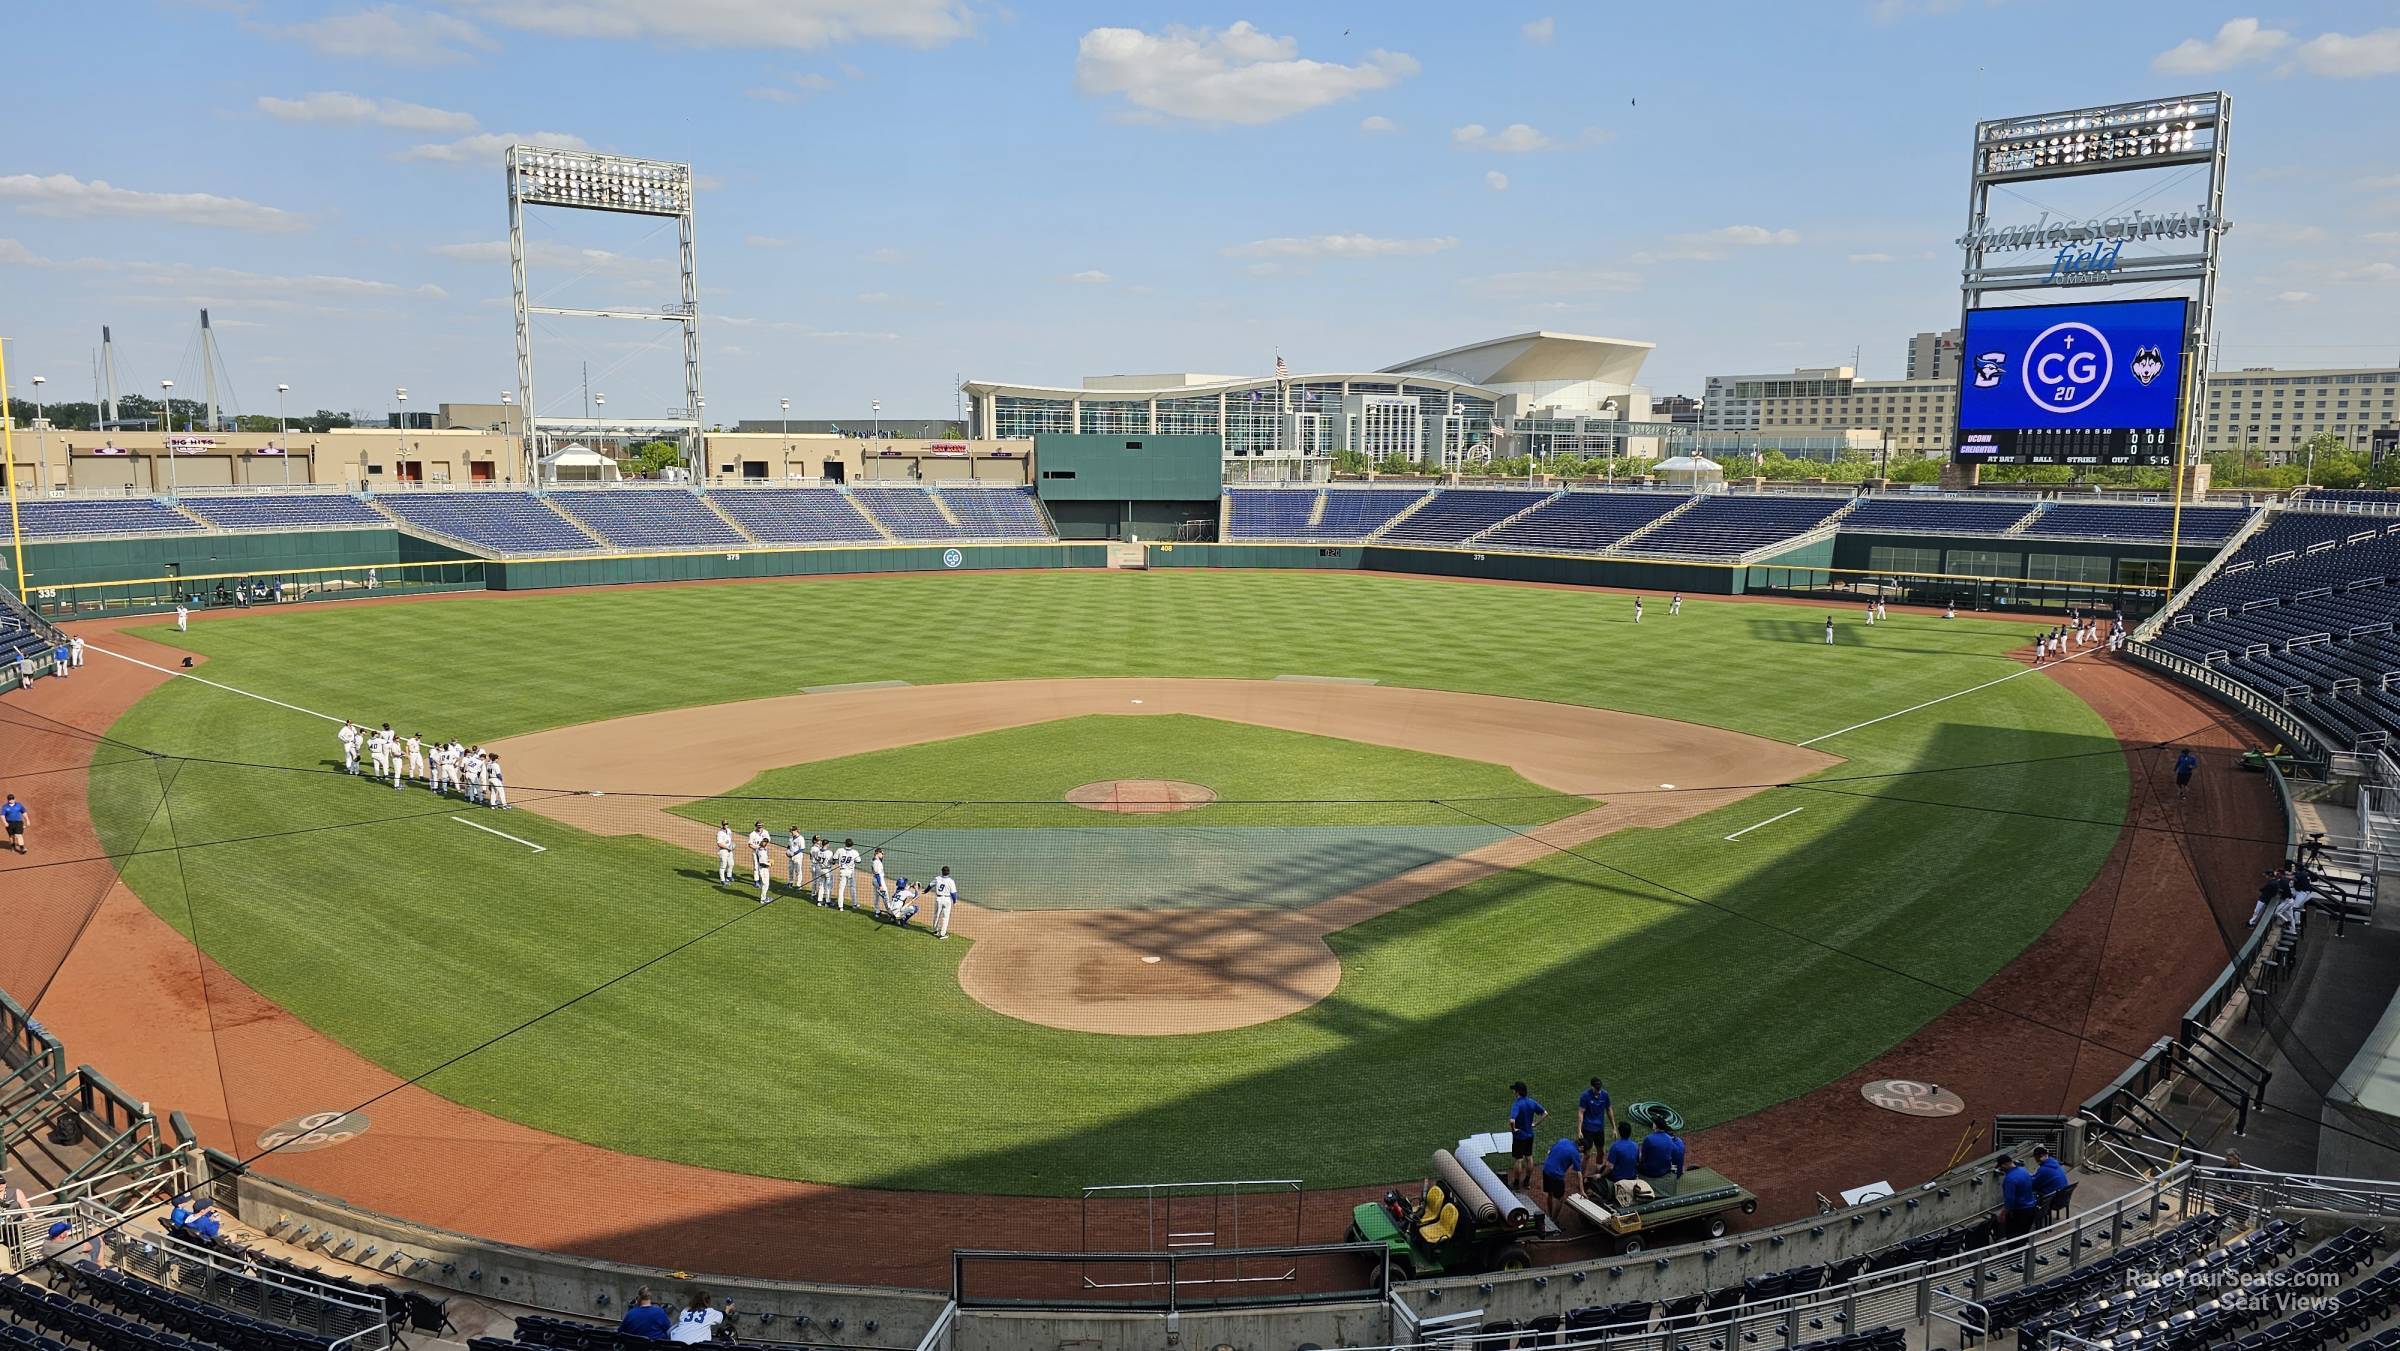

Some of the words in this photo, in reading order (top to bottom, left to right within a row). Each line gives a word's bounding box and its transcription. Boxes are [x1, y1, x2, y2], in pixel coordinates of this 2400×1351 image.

[2041, 240, 2123, 283] field
[2055, 272, 2111, 285] OMAHA
[2037, 352, 2097, 384] CG
[2054, 386, 2075, 400] 20
[1967, 434, 1992, 443] UCONN
[2131, 434, 2138, 444] 0
[2147, 434, 2154, 444] 0
[2157, 434, 2165, 444] 0
[1960, 445, 1998, 454] CREIGHTON
[2130, 444, 2138, 455] 0
[38, 589, 56, 598] 335
[2139, 589, 2157, 597] 335
[938, 883, 945, 892] 9
[684, 1310, 707, 1323] 33
